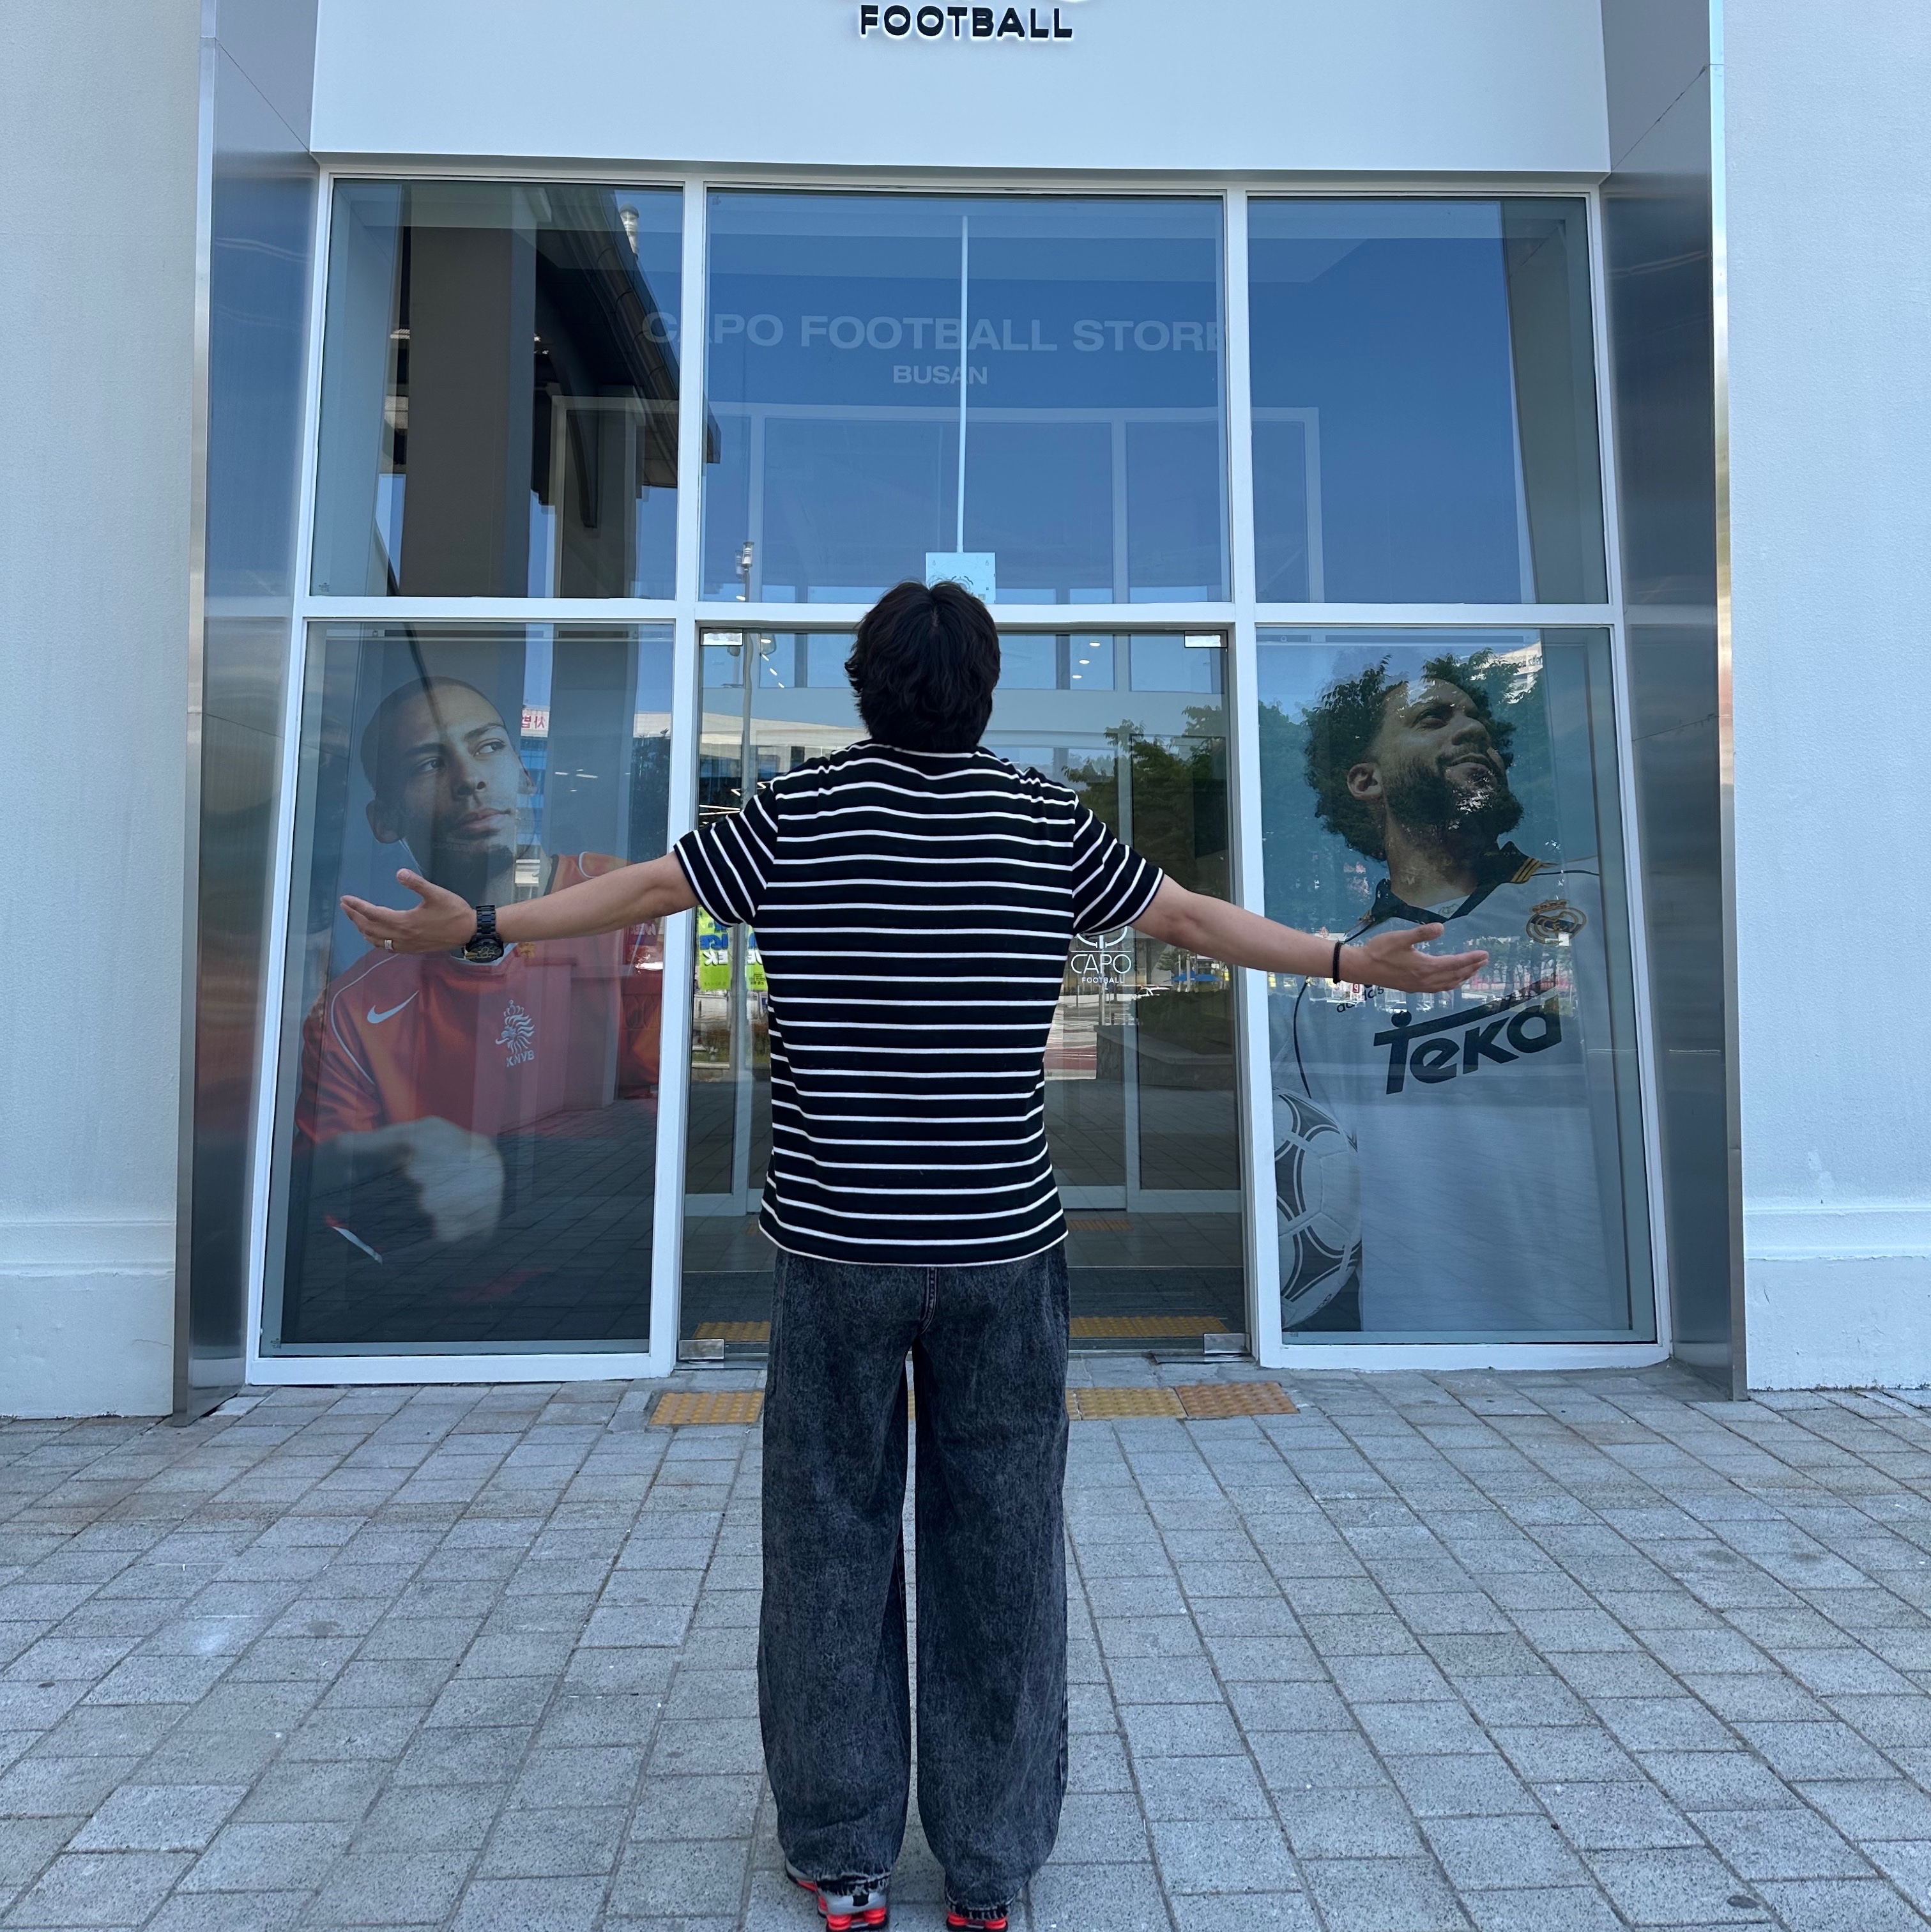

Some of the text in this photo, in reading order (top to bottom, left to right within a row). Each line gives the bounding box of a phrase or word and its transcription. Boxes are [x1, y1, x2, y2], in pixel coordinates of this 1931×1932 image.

[860, 4, 1073, 38] FOOTBALL
[642, 311, 784, 347] CPO
[800, 315, 1057, 351] FOOTBALL
[893, 365, 988, 385] BUSAN
[1071, 953, 1132, 974] CAPO
[506, 1050, 535, 1068] KNVB
